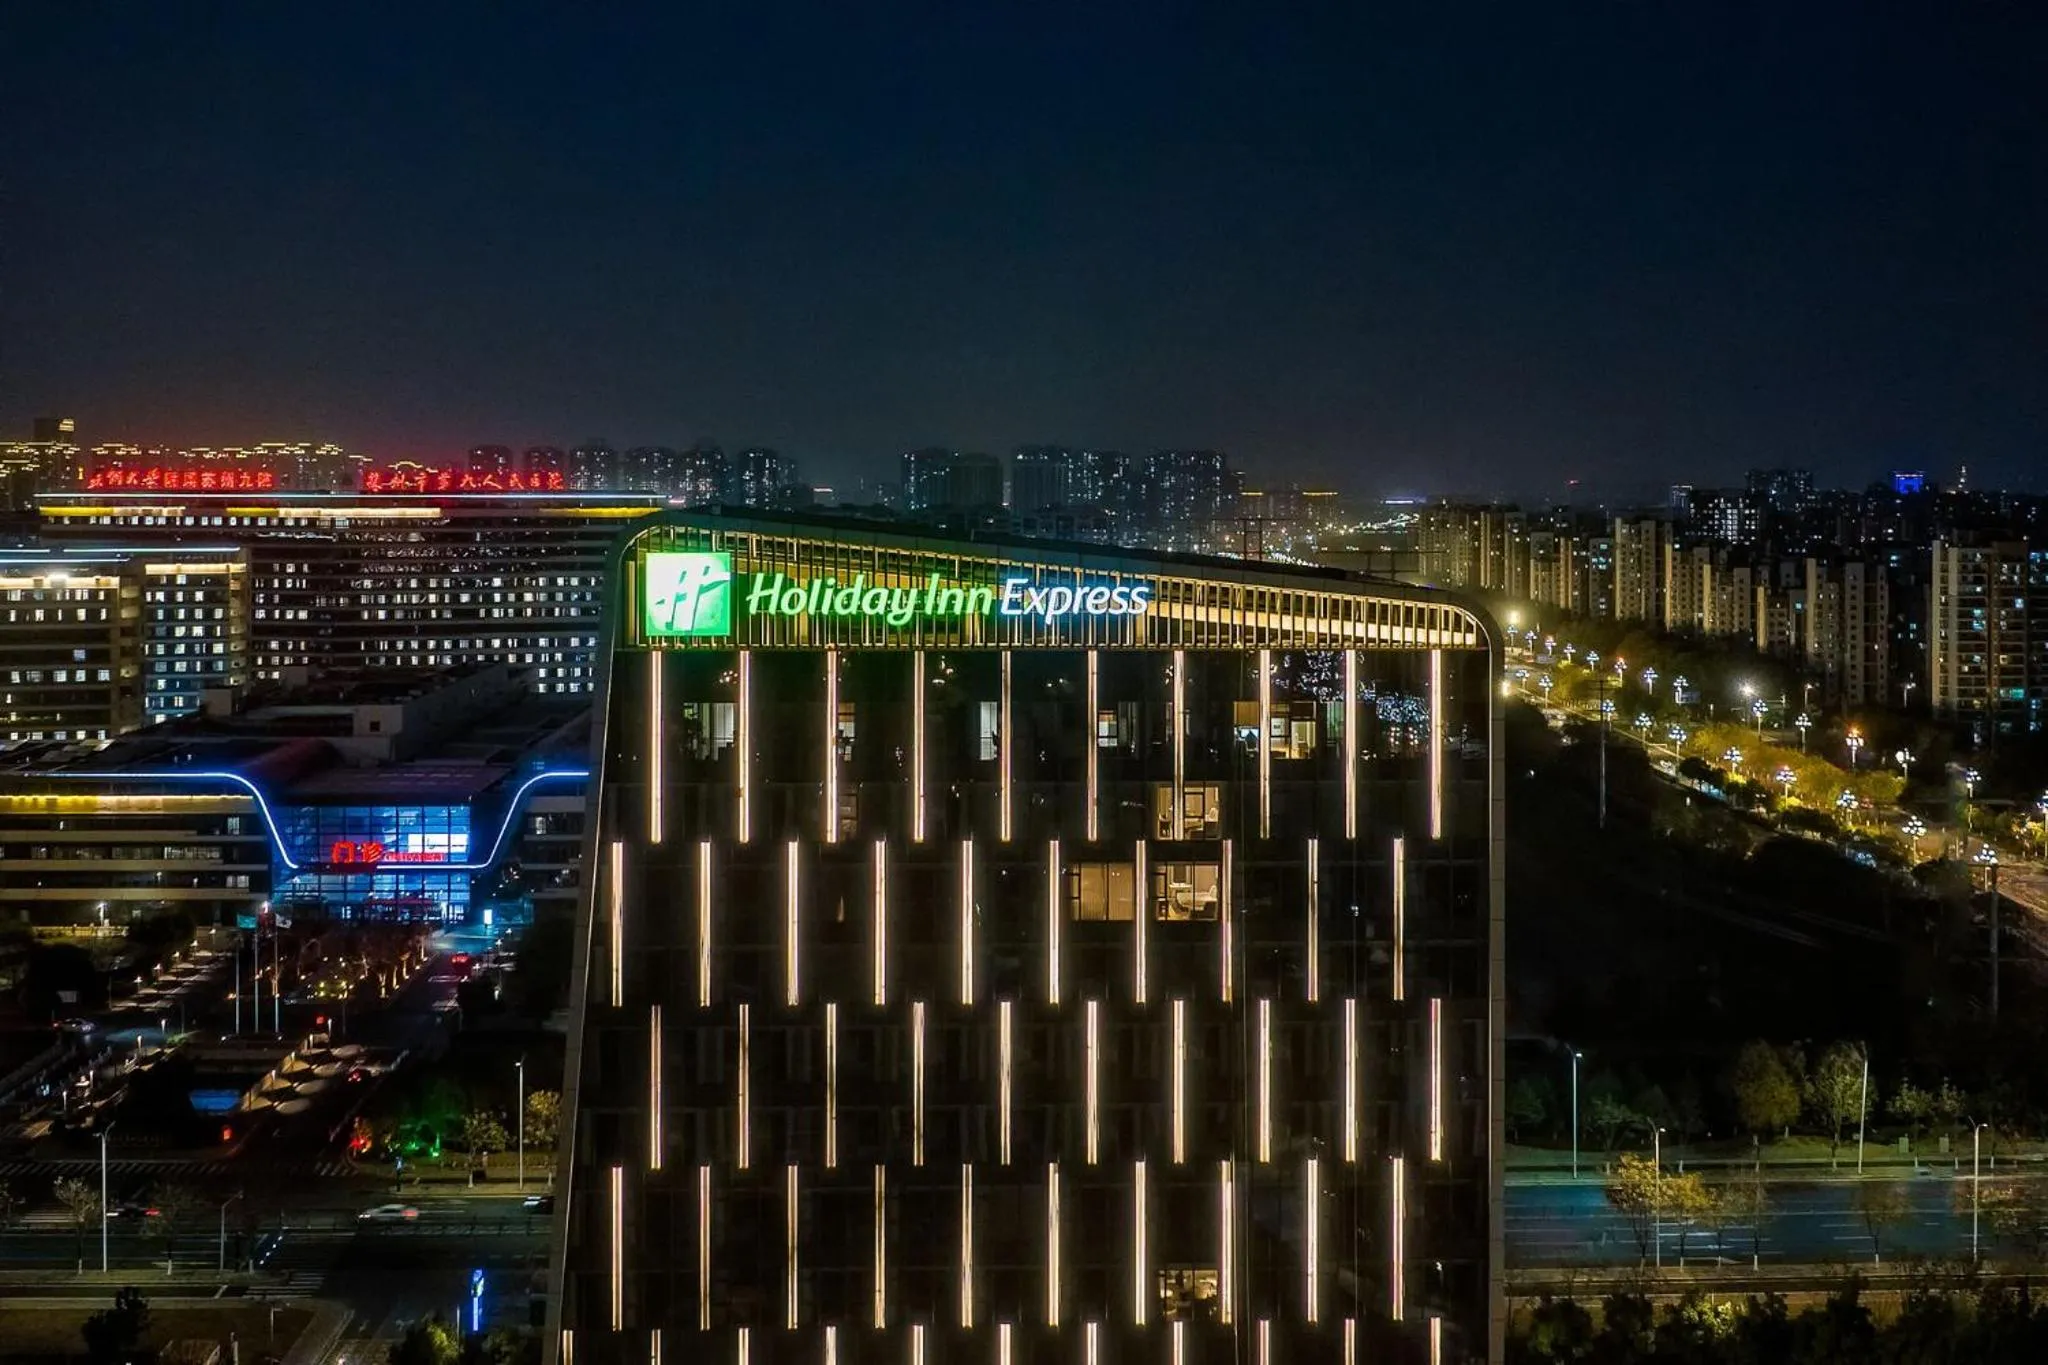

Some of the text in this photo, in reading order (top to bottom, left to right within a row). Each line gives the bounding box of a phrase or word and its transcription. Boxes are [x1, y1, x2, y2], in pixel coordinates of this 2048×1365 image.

[746, 572, 1149, 626] Holiday Inn Express
[331, 840, 384, 864] 门诊
